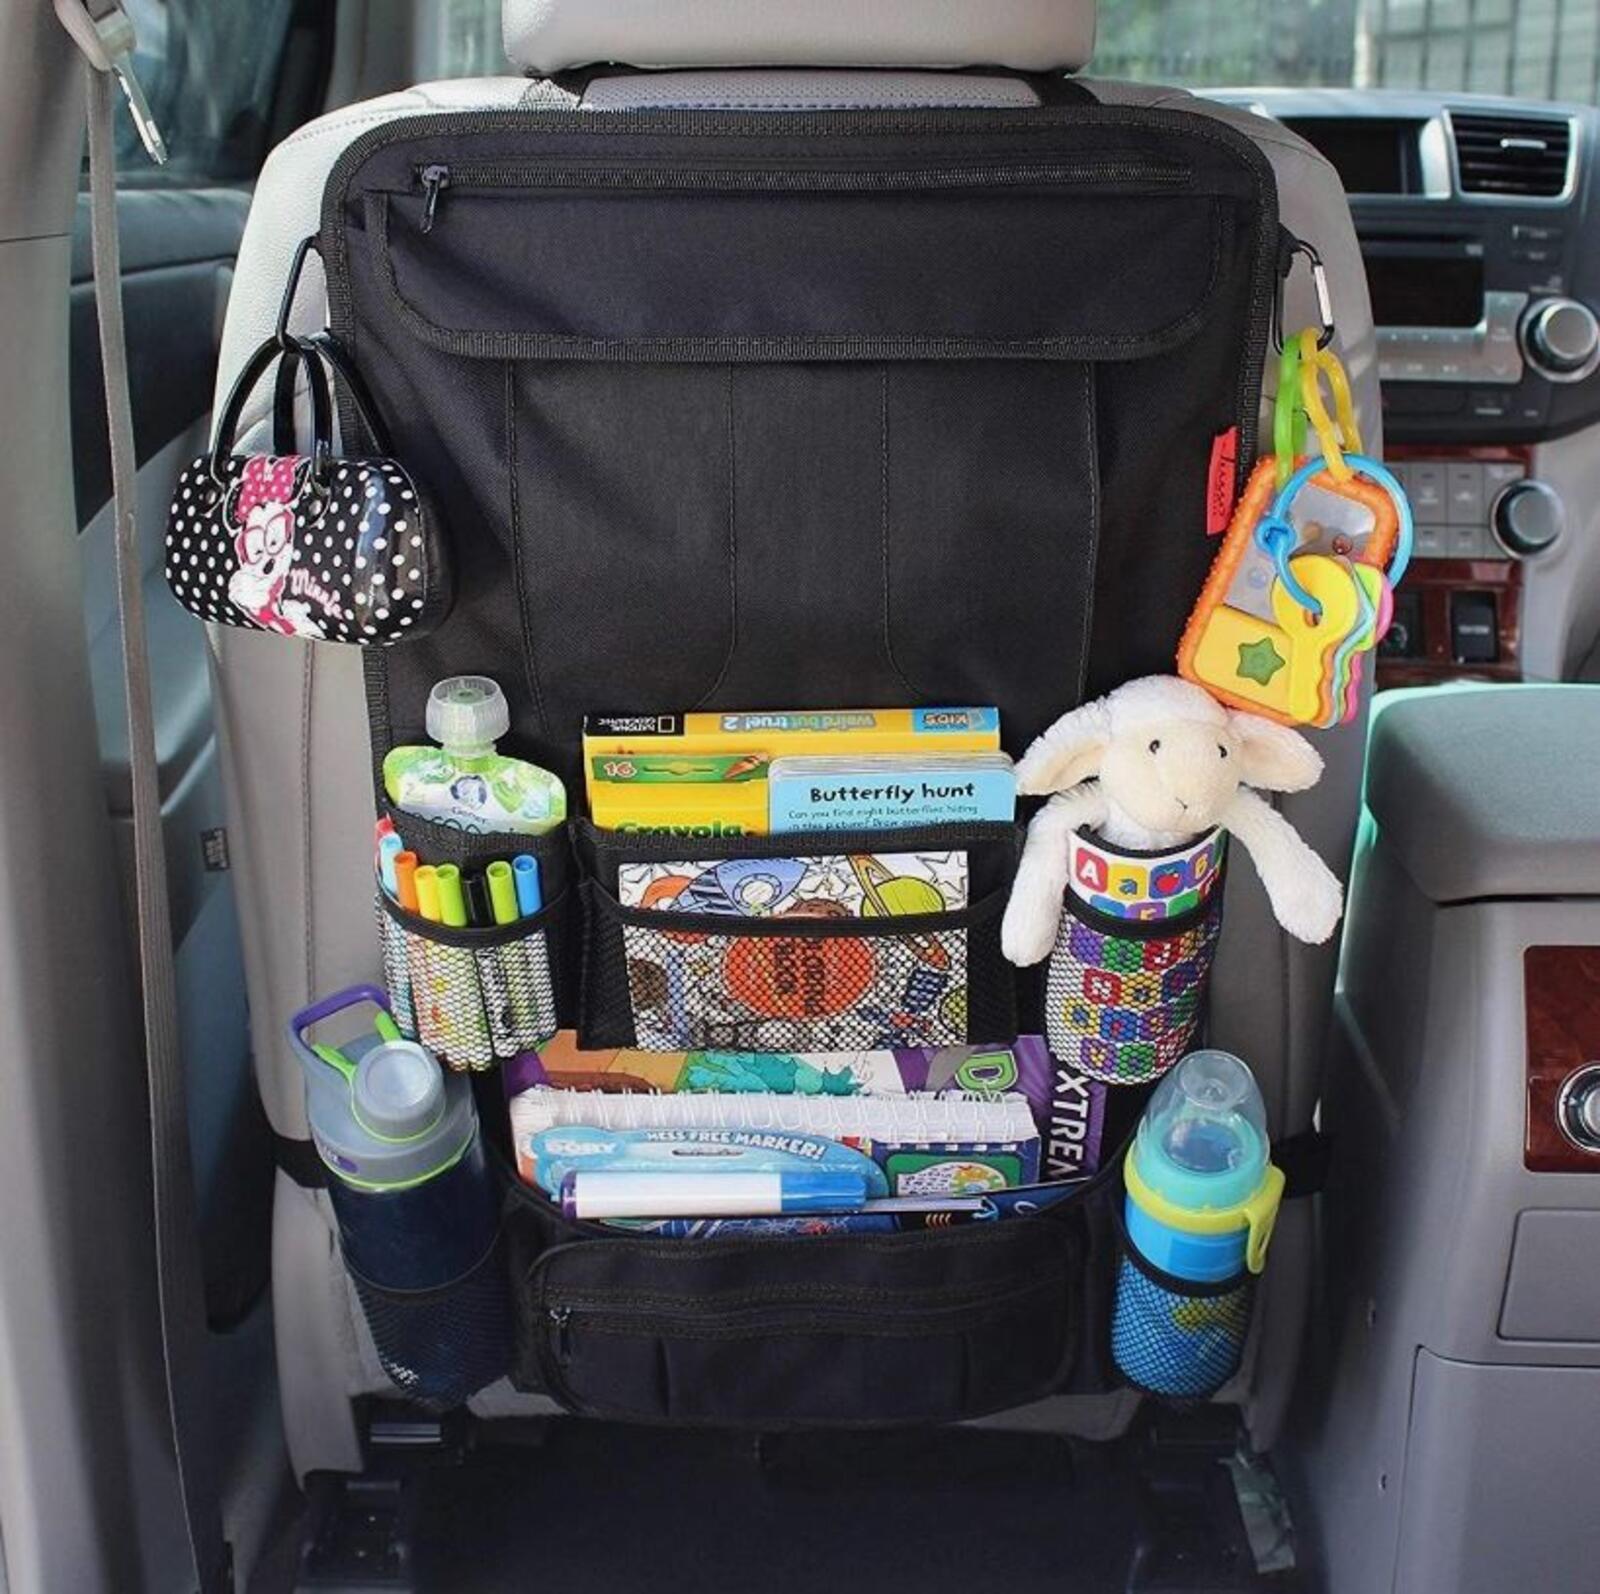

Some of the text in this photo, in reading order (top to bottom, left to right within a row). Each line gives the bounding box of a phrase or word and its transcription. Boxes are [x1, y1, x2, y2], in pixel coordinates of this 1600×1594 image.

[722, 715, 740, 731] 2
[744, 715, 788, 730] true!
[789, 714, 822, 730] but
[924, 713, 969, 725] KIDS
[603, 761, 638, 778] 16
[810, 782, 976, 804] Butterfly hunt
[788, 810, 808, 819] Can
[811, 811, 829, 819] you
[1079, 859, 1100, 887] A
[1118, 877, 1138, 896] a
[647, 1130, 826, 1161] MESS FREE MARKER!
